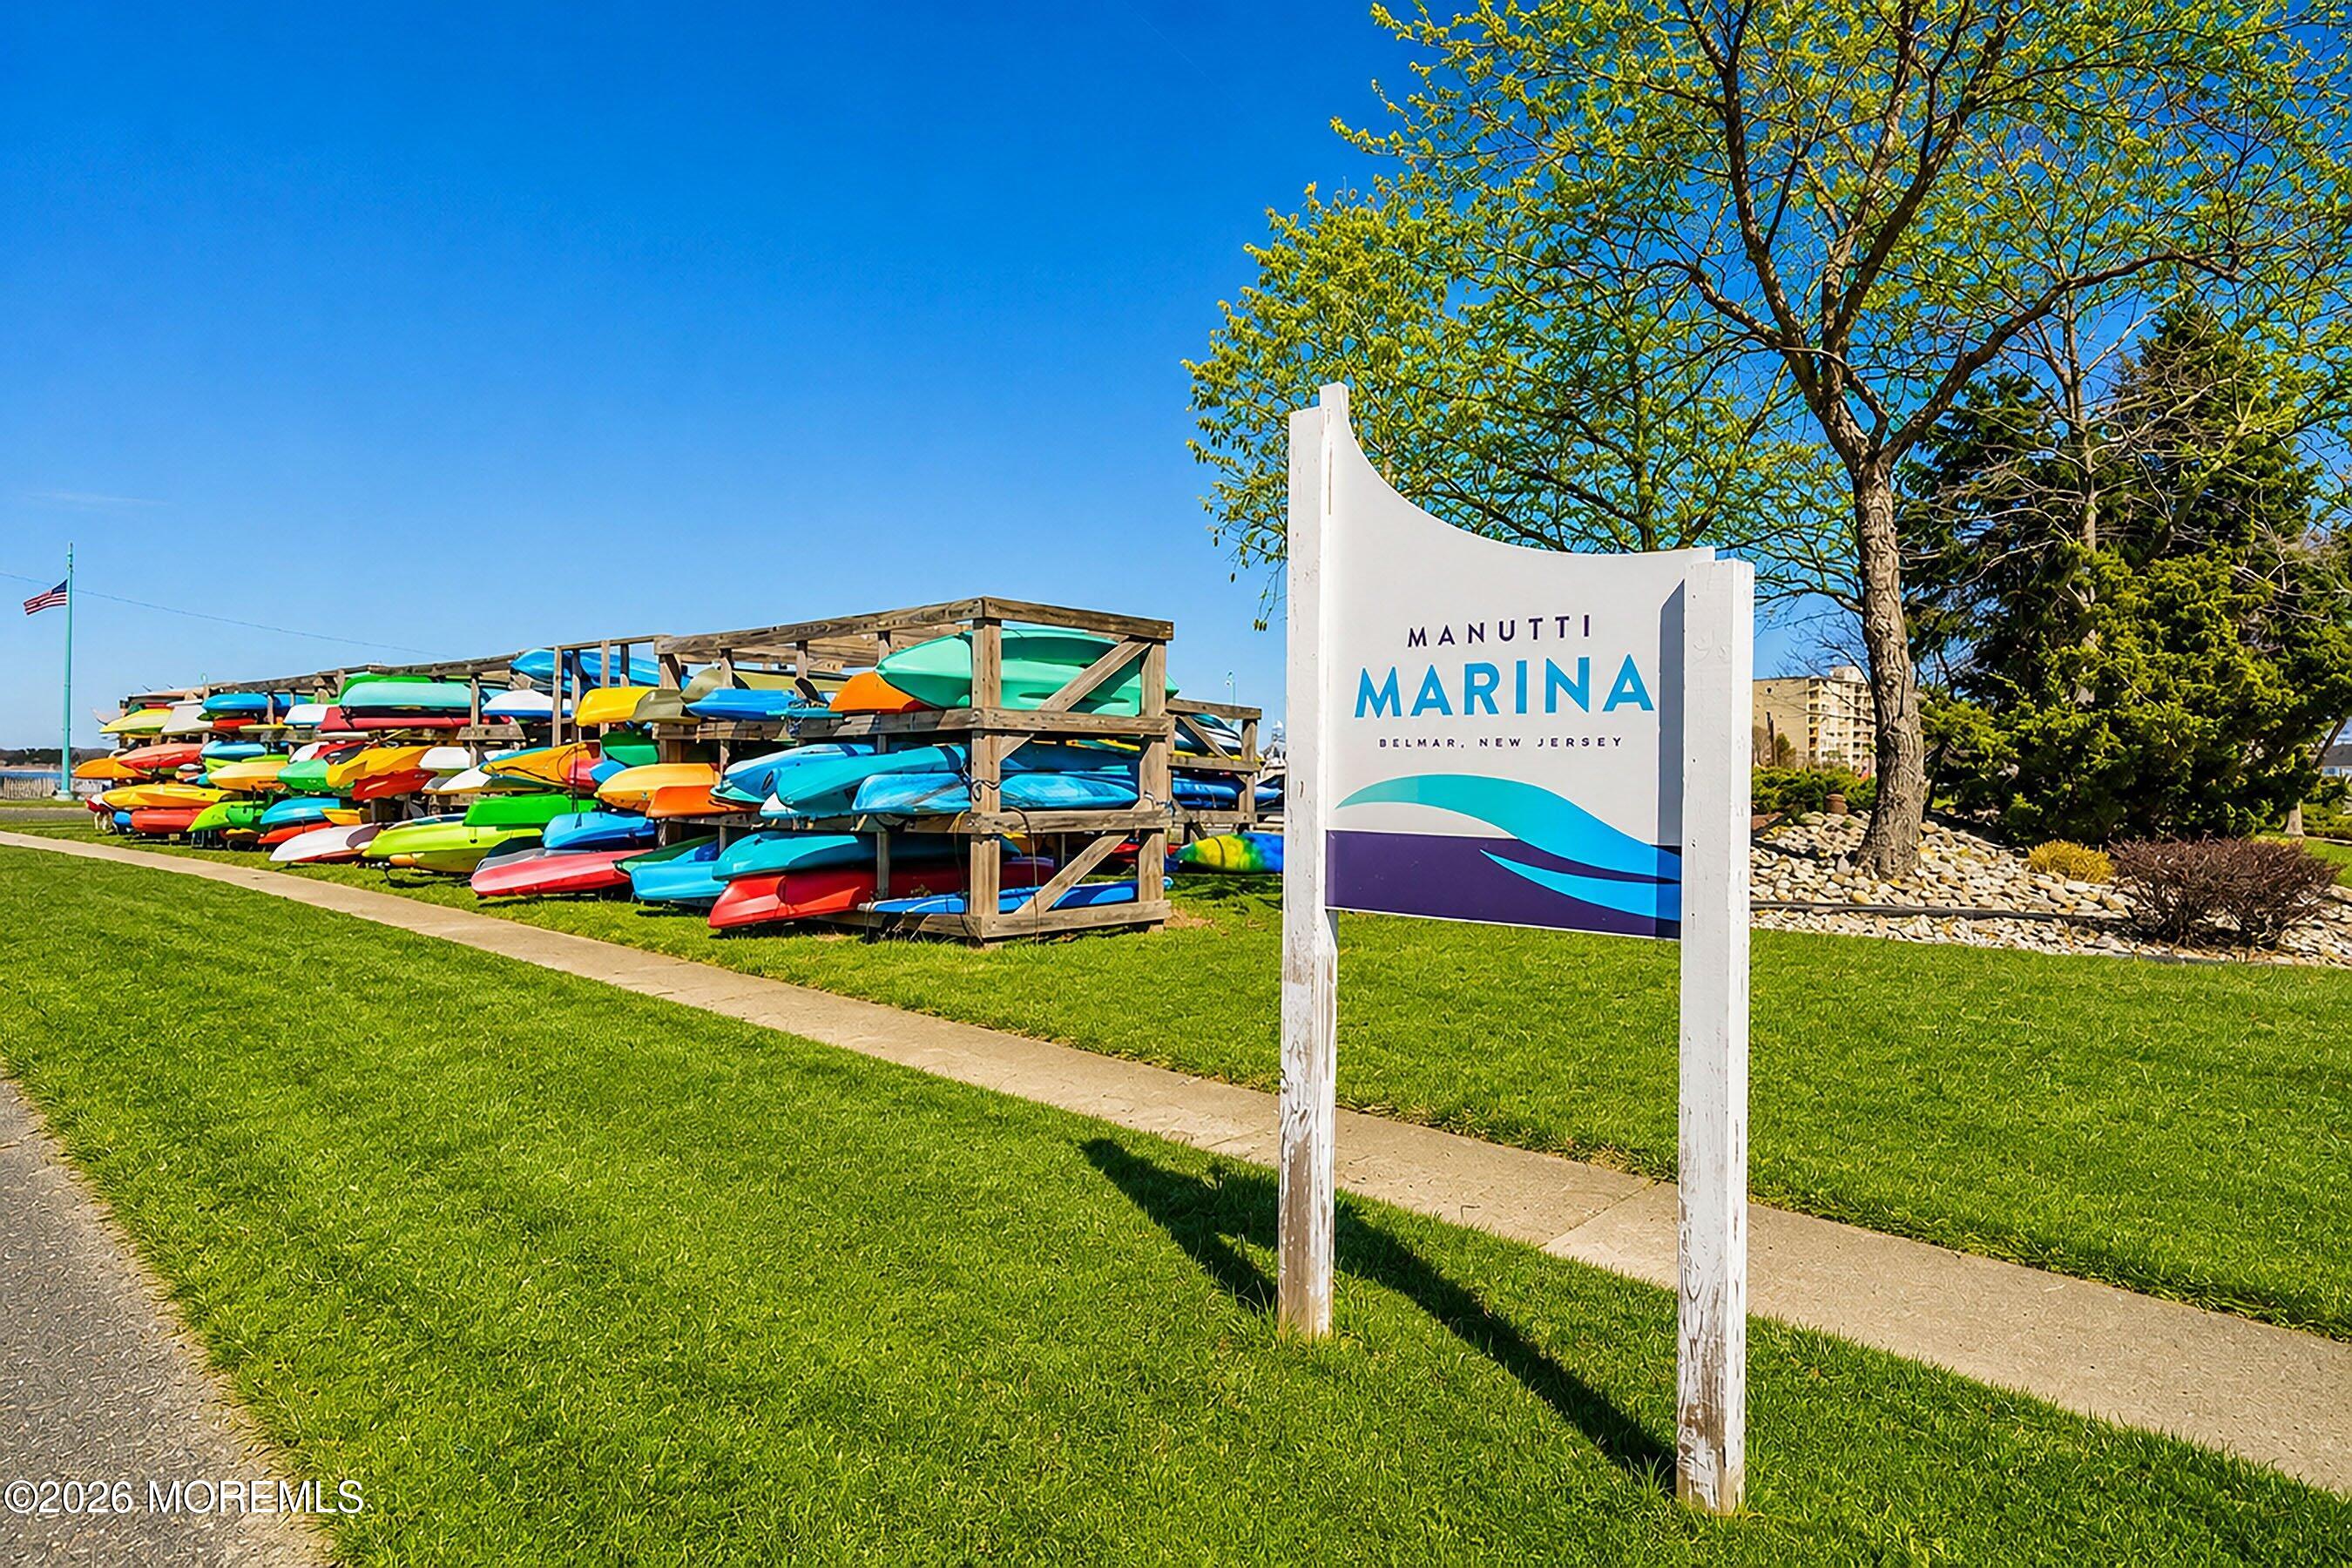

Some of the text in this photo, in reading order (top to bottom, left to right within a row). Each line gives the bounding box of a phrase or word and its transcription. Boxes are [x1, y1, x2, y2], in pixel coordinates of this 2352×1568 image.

[1407, 614, 1592, 648] MANUTTI
[1354, 653, 1655, 719] MARINA
[1379, 736, 1623, 748] BELMAR, NEW JERSEY
